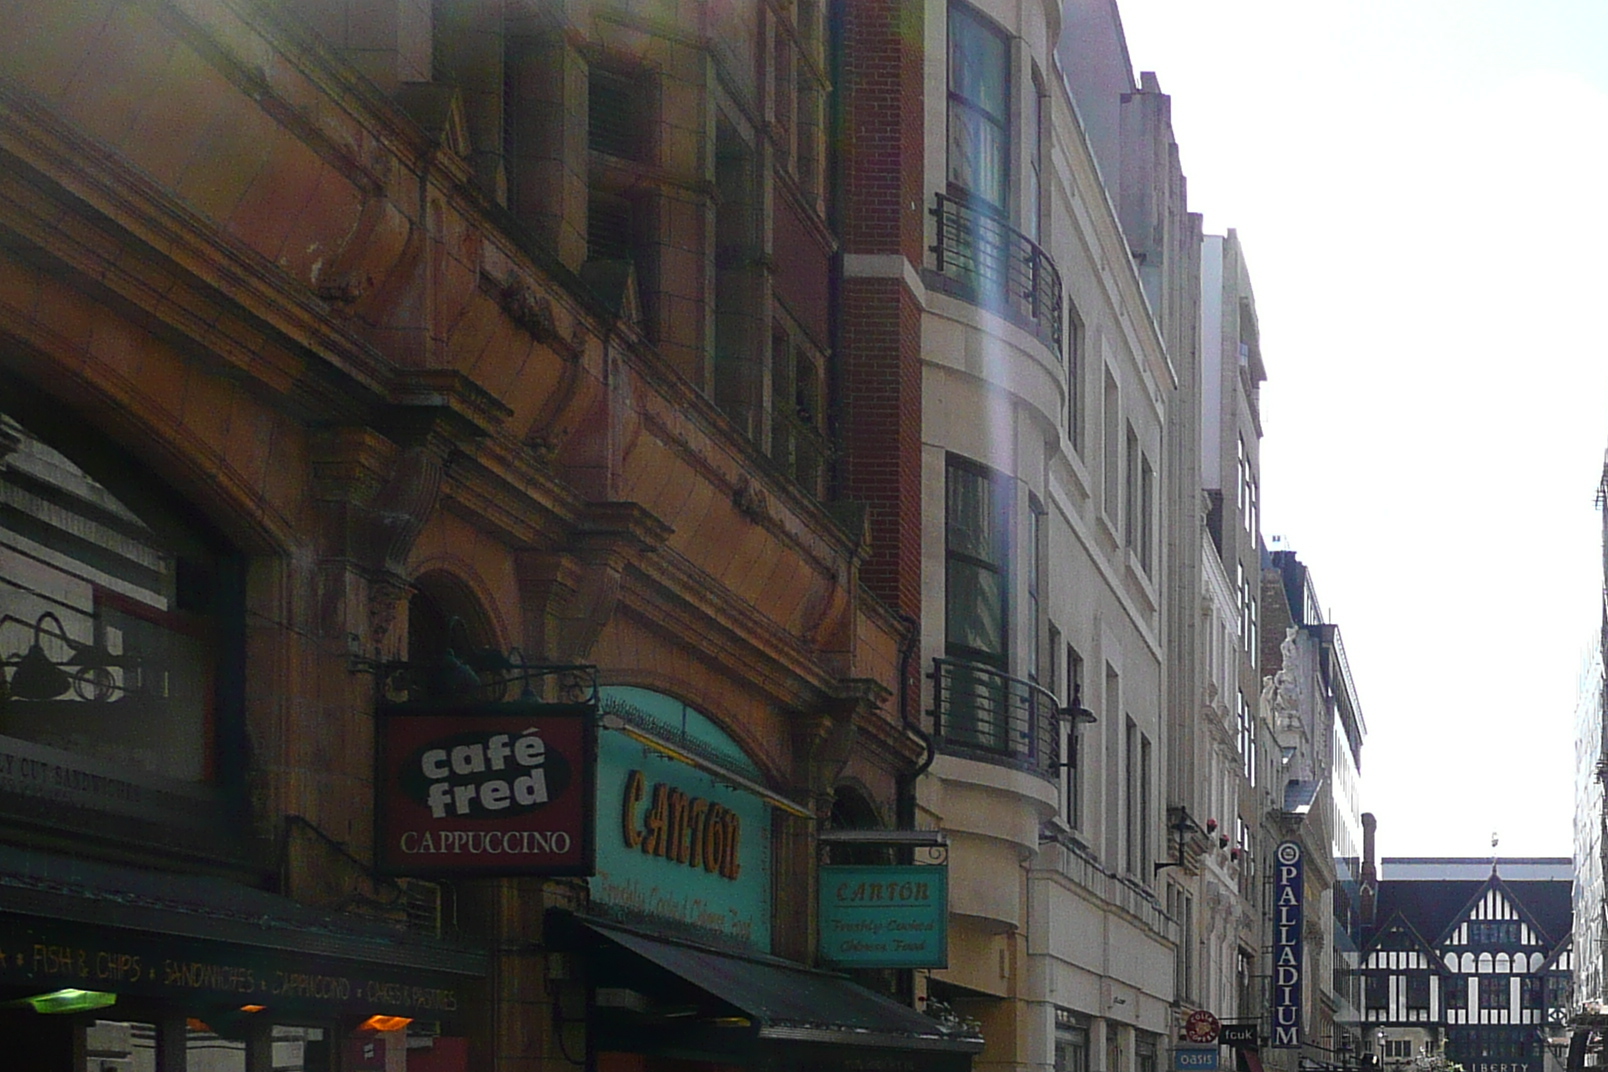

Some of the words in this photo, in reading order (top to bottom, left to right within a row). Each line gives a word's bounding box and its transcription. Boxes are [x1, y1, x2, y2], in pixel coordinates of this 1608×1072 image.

[421, 726, 546, 779] café
[427, 767, 549, 819] fred
[400, 831, 571, 854] CAPPUCCINO
[33, 943, 73, 973] FISH
[97, 951, 141, 982] CHIPS
[1275, 866, 1299, 1045] PALLADIUM
[1225, 1029, 1254, 1040] fcuk
[1180, 1054, 1213, 1065] oasis
